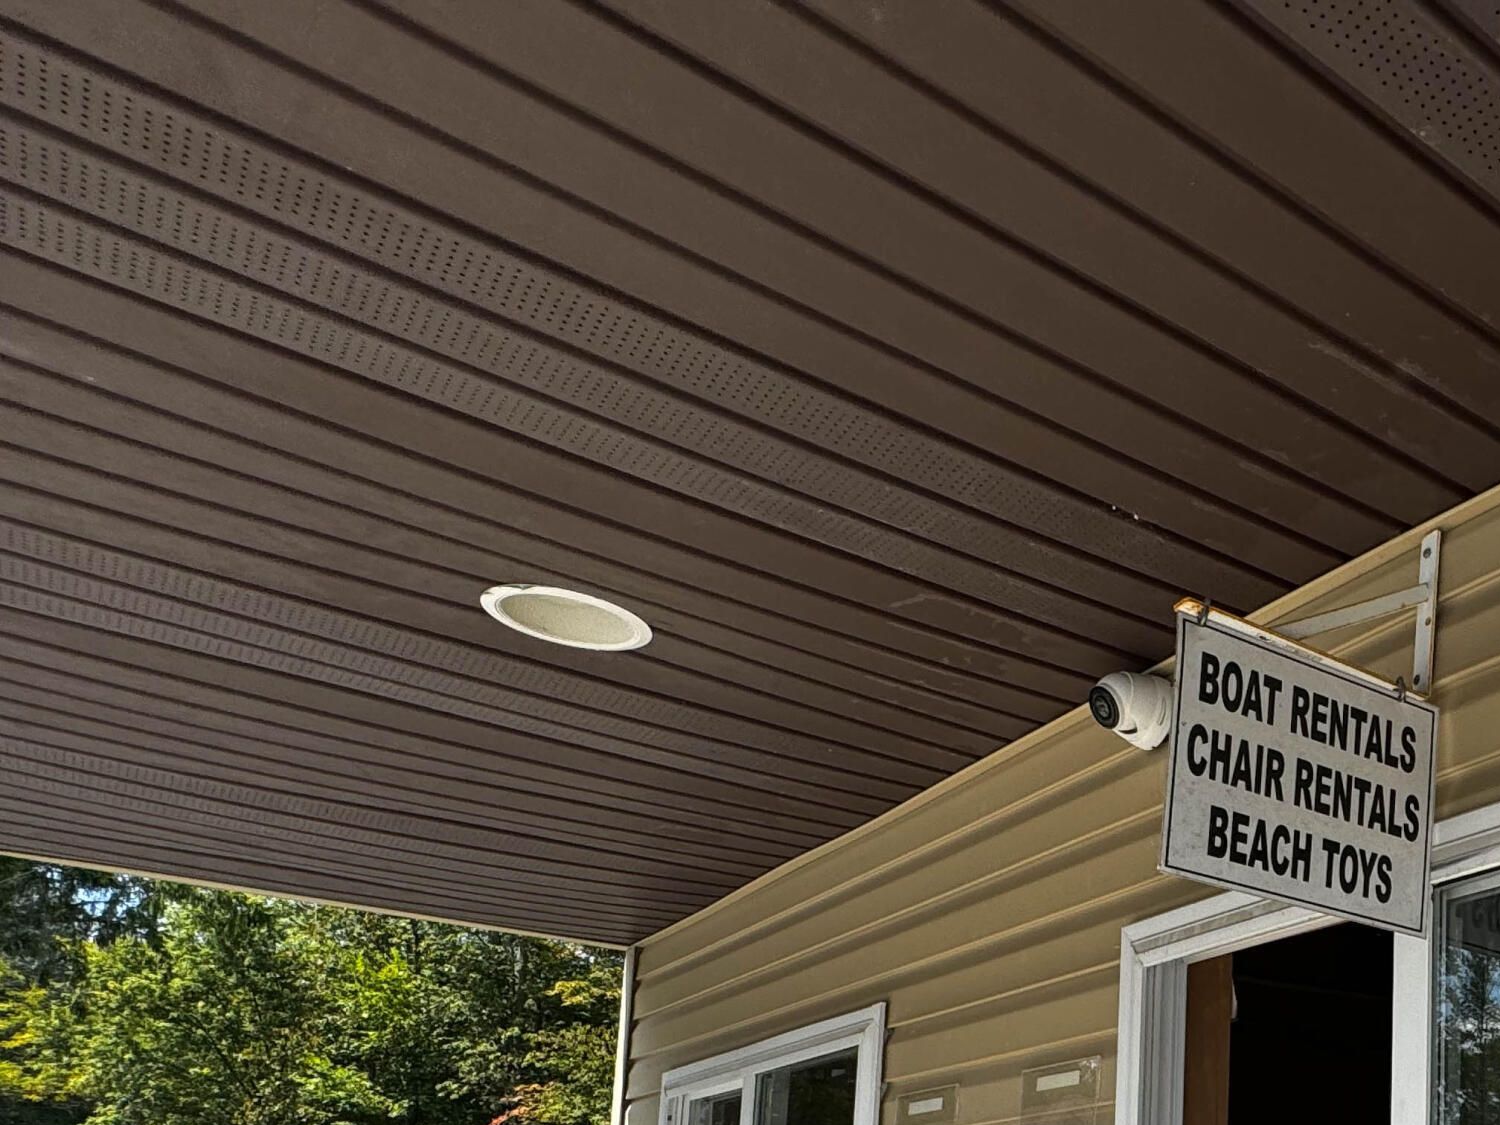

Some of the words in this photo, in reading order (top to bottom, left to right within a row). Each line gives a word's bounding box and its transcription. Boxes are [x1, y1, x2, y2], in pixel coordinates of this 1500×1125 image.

[1199, 651, 1282, 726] BOAT
[1290, 685, 1416, 773] RENTALS
[1187, 724, 1285, 802] CHAIR
[1294, 757, 1420, 842] RENTALS
[1207, 805, 1312, 882] BEACH
[1322, 838, 1392, 903] TOYS
